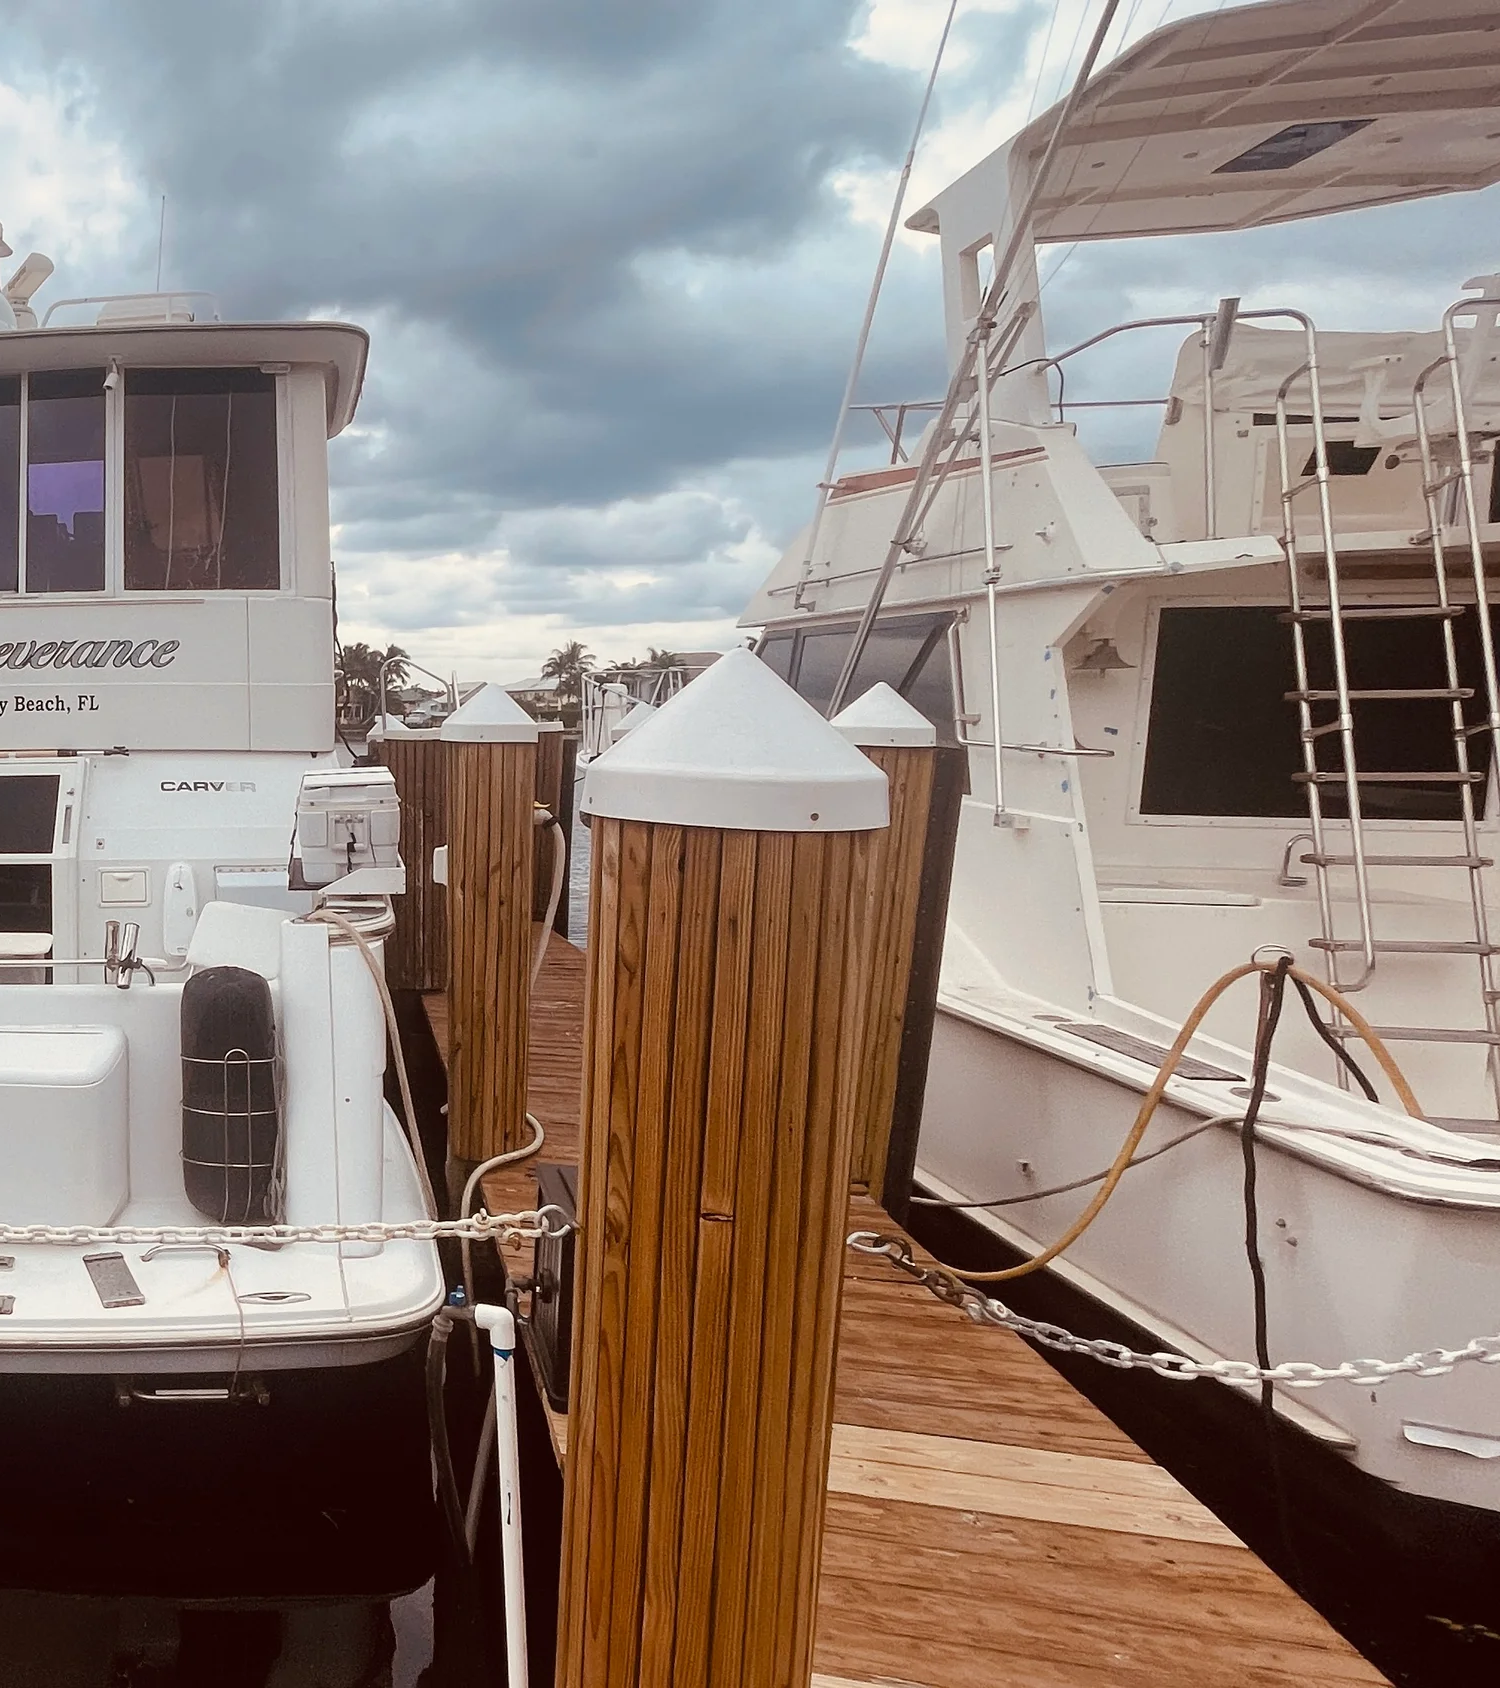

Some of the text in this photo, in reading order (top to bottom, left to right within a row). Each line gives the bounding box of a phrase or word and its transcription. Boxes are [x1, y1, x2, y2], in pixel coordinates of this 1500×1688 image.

[13, 694, 71, 715] Beach,
[77, 695, 100, 711] FL
[160, 781, 257, 793] CARVER
